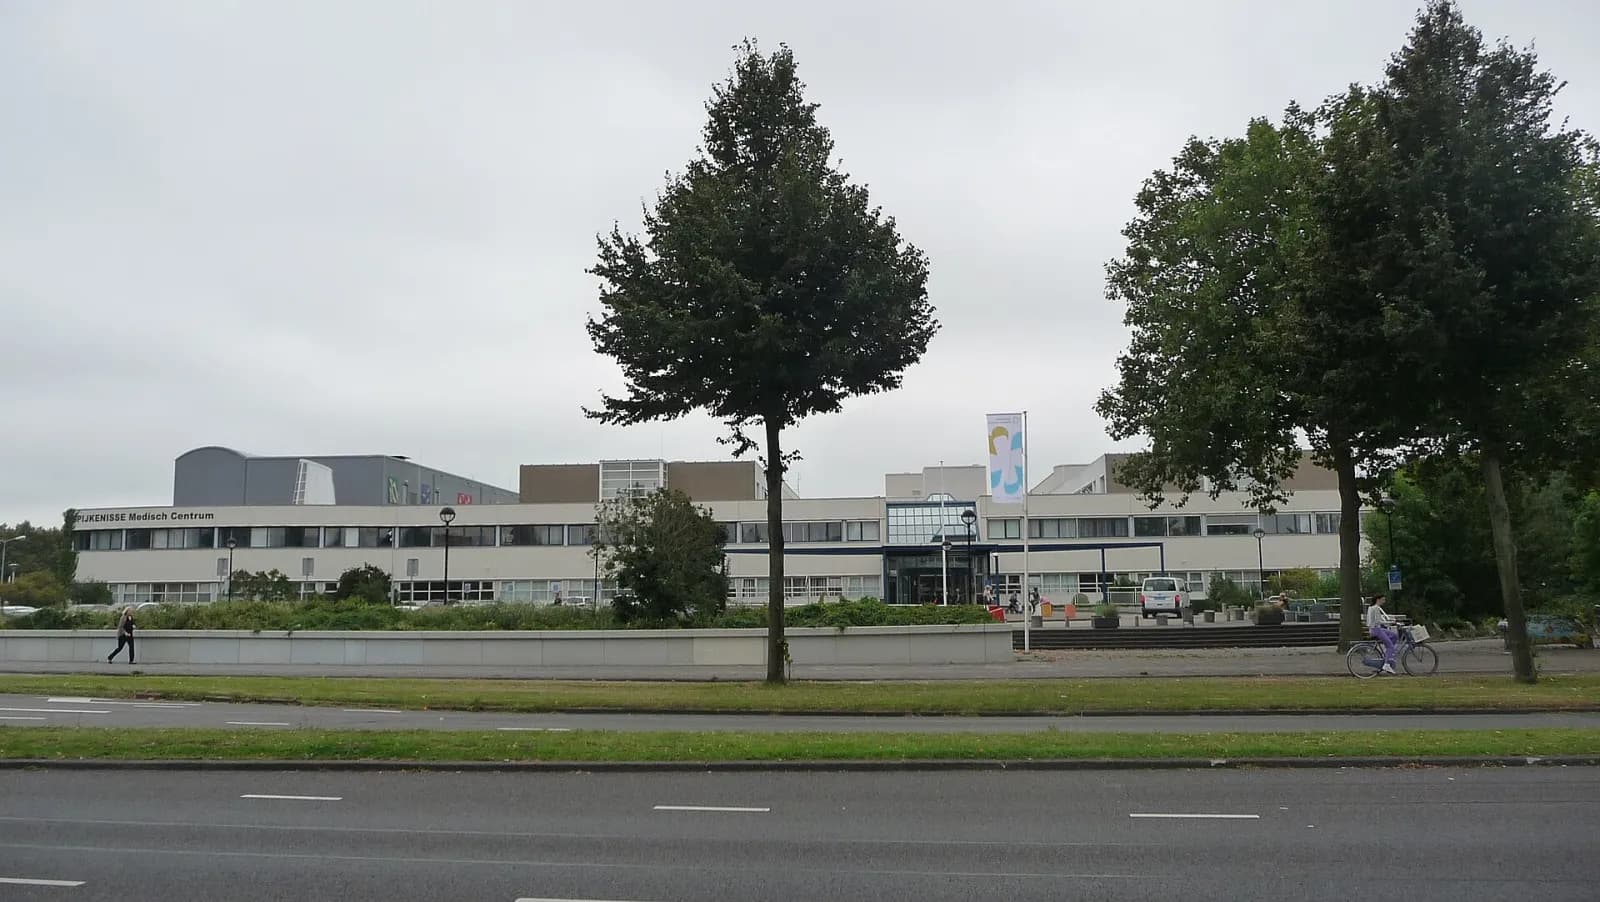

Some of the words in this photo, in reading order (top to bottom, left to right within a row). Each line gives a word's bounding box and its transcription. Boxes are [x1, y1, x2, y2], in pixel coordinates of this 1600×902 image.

[77, 513, 126, 522] PIJKENISSE
[128, 512, 167, 521] Medisch
[170, 511, 214, 520] Centrum
